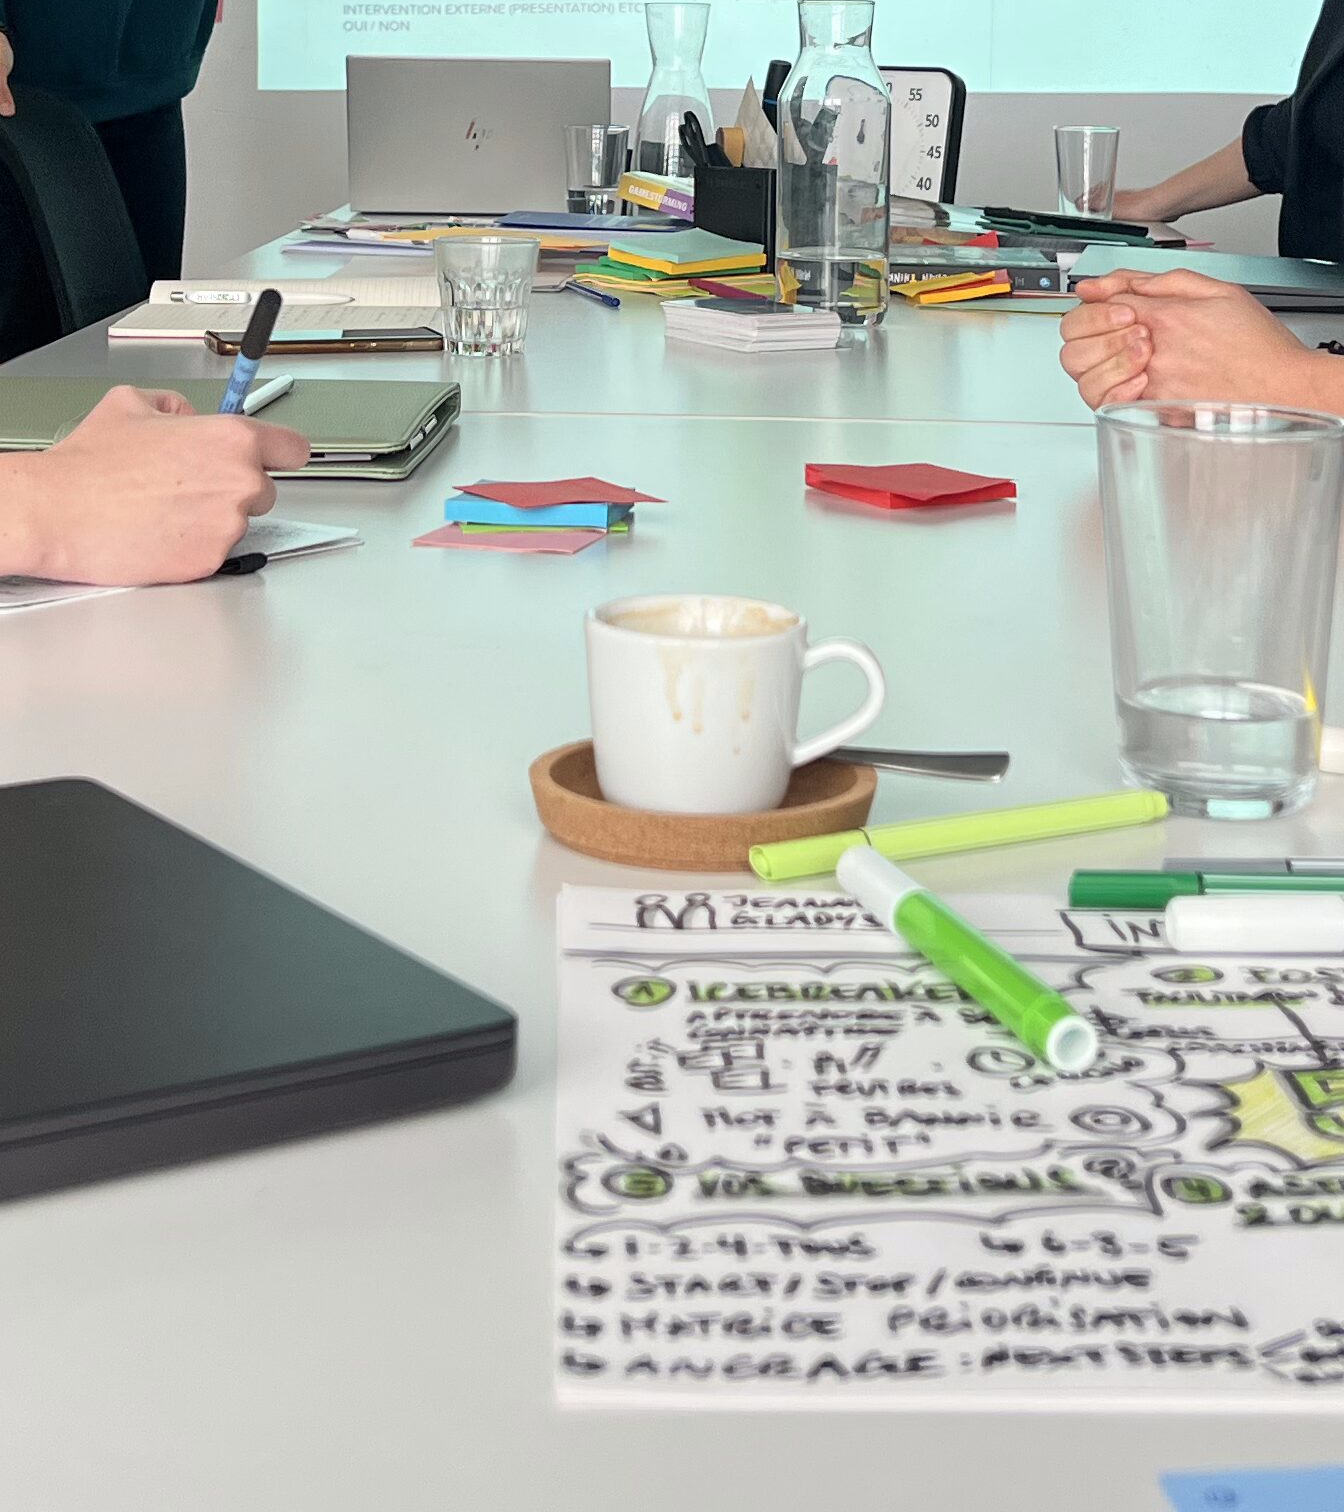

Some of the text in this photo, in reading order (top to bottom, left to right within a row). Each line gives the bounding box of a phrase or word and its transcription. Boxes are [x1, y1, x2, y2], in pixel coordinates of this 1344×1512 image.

[342, 2, 443, 16] INTERVENTION
[444, 2, 506, 16] EXTERNE
[342, 19, 370, 34] OUI
[377, 19, 412, 33] NON
[908, 88, 923, 102] 55
[924, 113, 940, 128] 50
[926, 145, 943, 159] 45
[915, 176, 932, 191] 40
[687, 978, 974, 1003] ICEBREAKE
